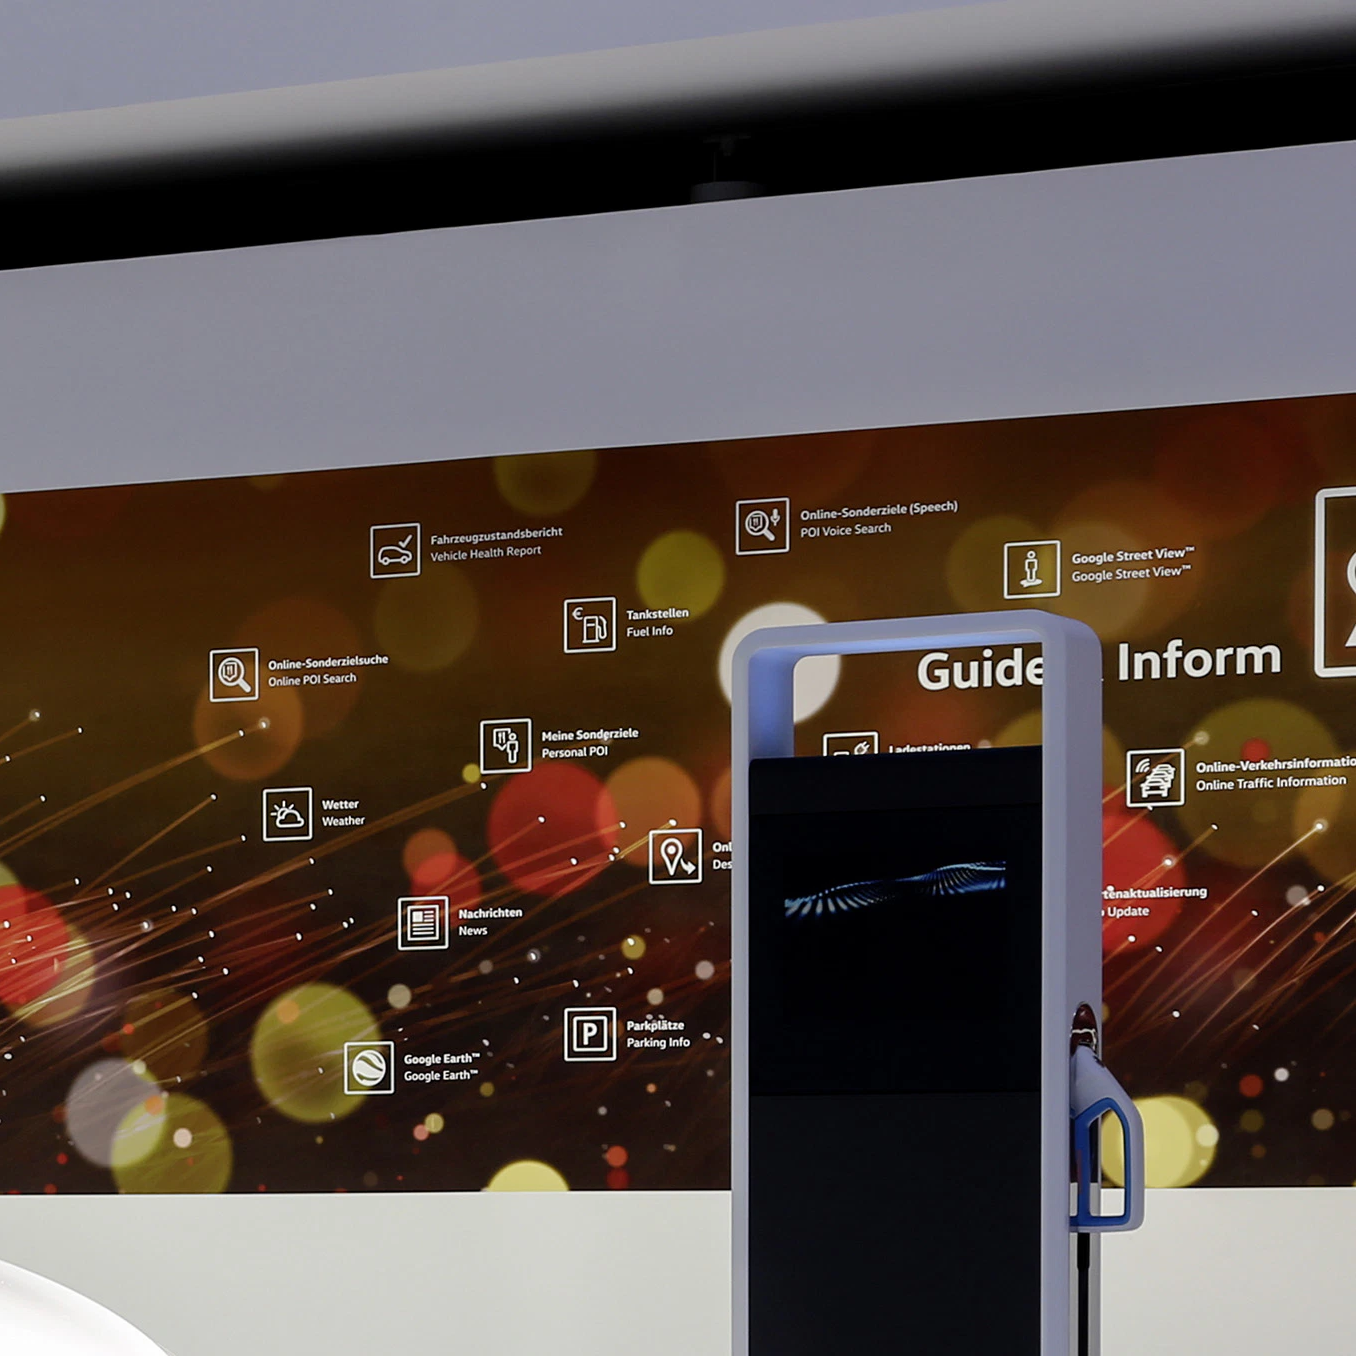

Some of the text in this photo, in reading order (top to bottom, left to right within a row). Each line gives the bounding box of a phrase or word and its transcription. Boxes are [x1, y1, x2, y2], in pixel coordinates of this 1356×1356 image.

[800, 500, 959, 521] Online-Sonderziele (Speech)
[430, 526, 563, 545] Fahrzeugzustandsbericht
[800, 522, 892, 538] POI Voice Search
[430, 546, 542, 562] Vehicle Health Report
[1071, 552, 1114, 565] Google
[1116, 550, 1153, 561] Street
[1071, 570, 1113, 583] Google
[1115, 568, 1150, 579] Street
[626, 607, 689, 620] Tankstellen
[627, 625, 674, 637] Fuel Info
[268, 654, 389, 670] Online-Sonderzielsuche
[1118, 639, 1281, 681] Inform
[268, 672, 357, 687] Online POI Search
[542, 728, 639, 742] Meine Sonderziele
[542, 745, 608, 758] Personal POI
[1196, 775, 1347, 791] Online Traffic Information
[322, 800, 359, 810] Wetter
[322, 815, 365, 826] Weather
[1101, 887, 1207, 899] tenaktualisierung
[458, 907, 523, 919] Nachrichten
[1107, 906, 1150, 919] Update
[458, 926, 488, 936] News
[627, 1020, 685, 1033] Parkplätze
[627, 1036, 691, 1050] Parking Info
[404, 1053, 442, 1067] Google
[404, 1070, 441, 1083] Google
